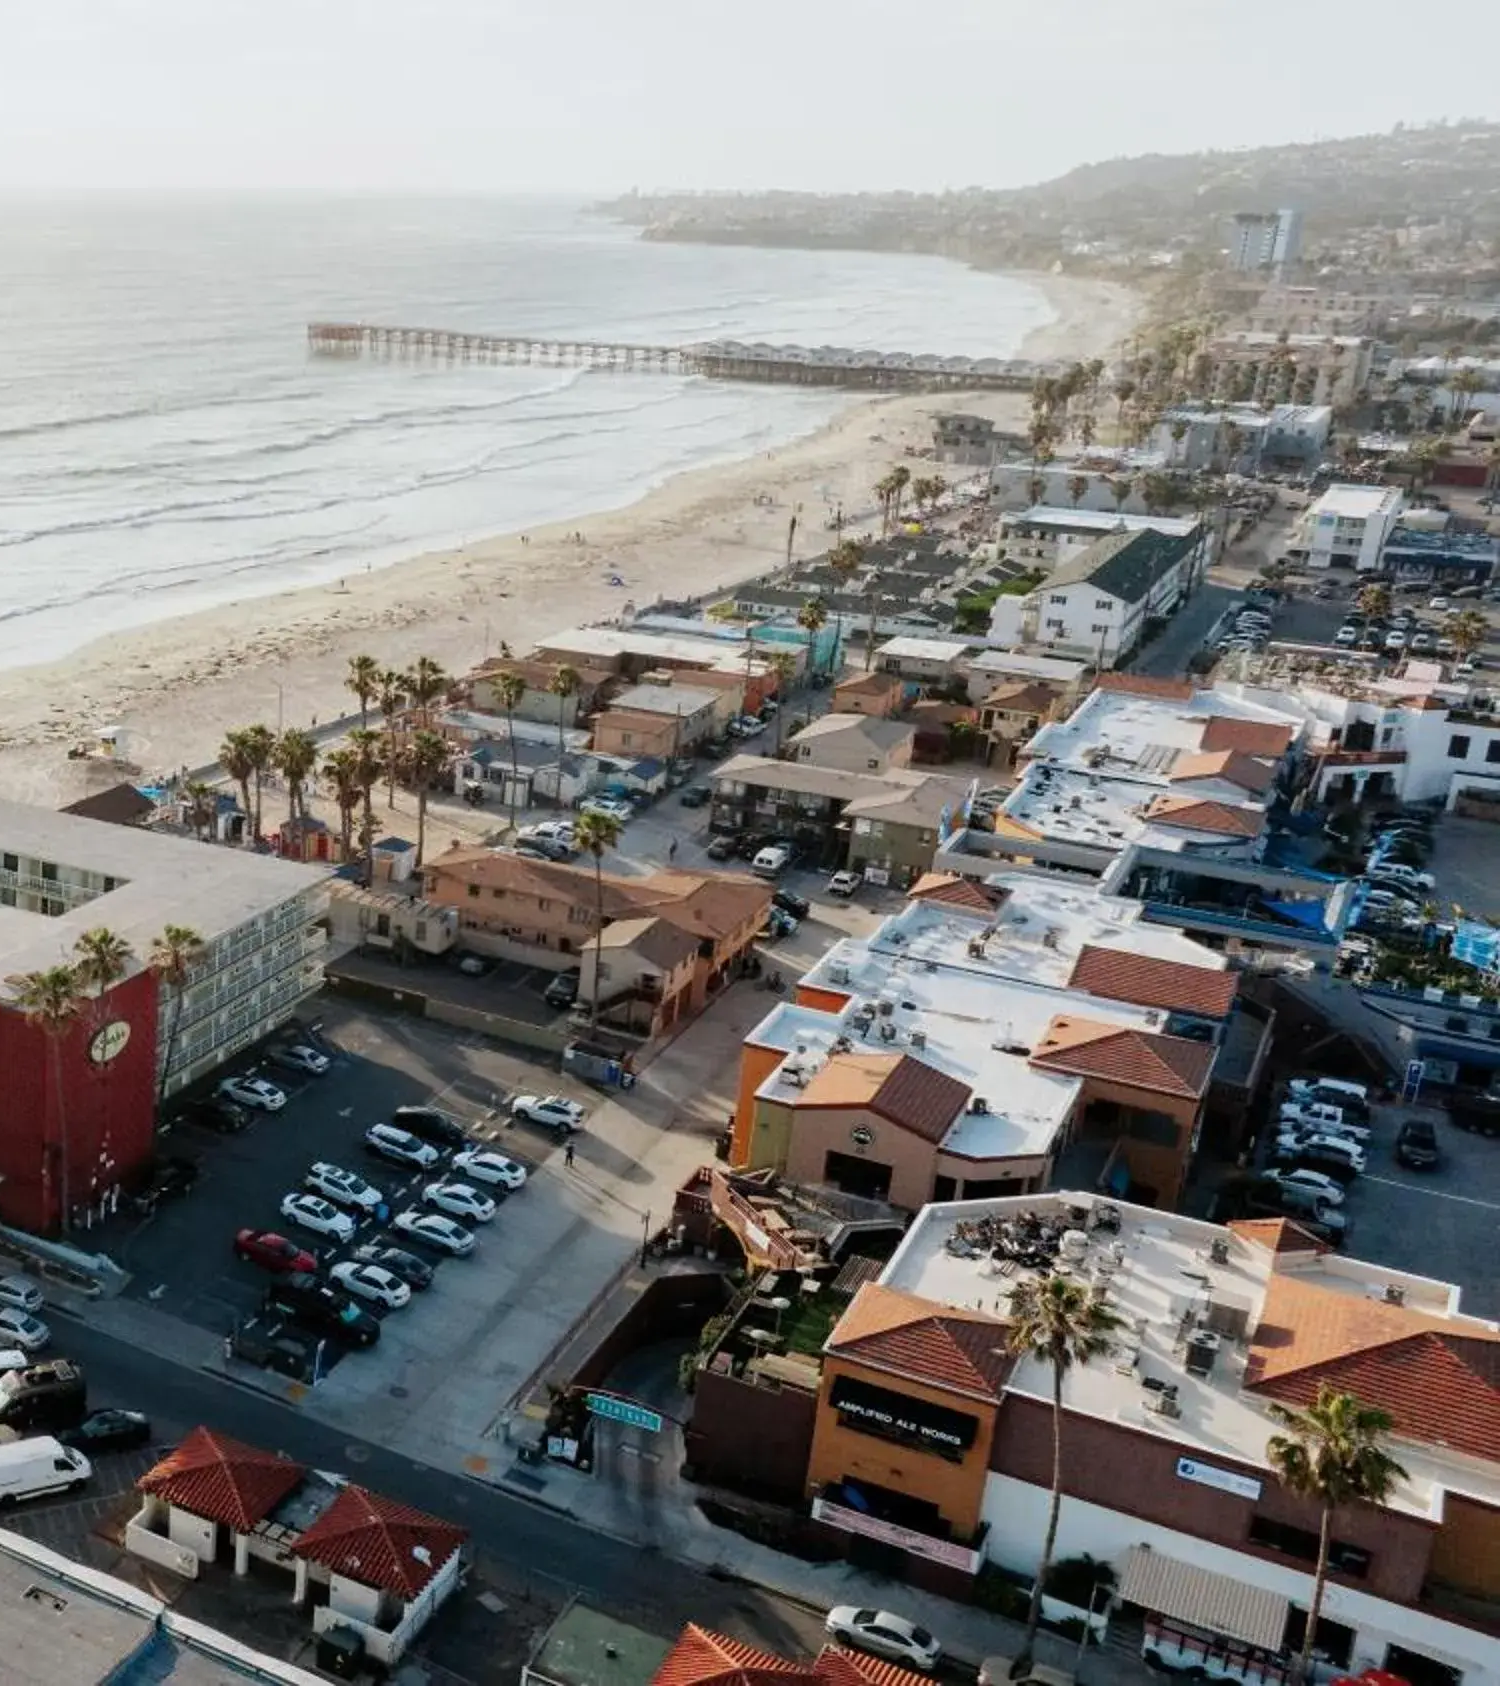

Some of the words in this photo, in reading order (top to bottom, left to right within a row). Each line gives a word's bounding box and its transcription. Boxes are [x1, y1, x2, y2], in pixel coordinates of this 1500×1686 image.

[836, 1400, 893, 1423] AMPLIFIED
[896, 1419, 917, 1432] ALE
[920, 1426, 961, 1445] WORKS
